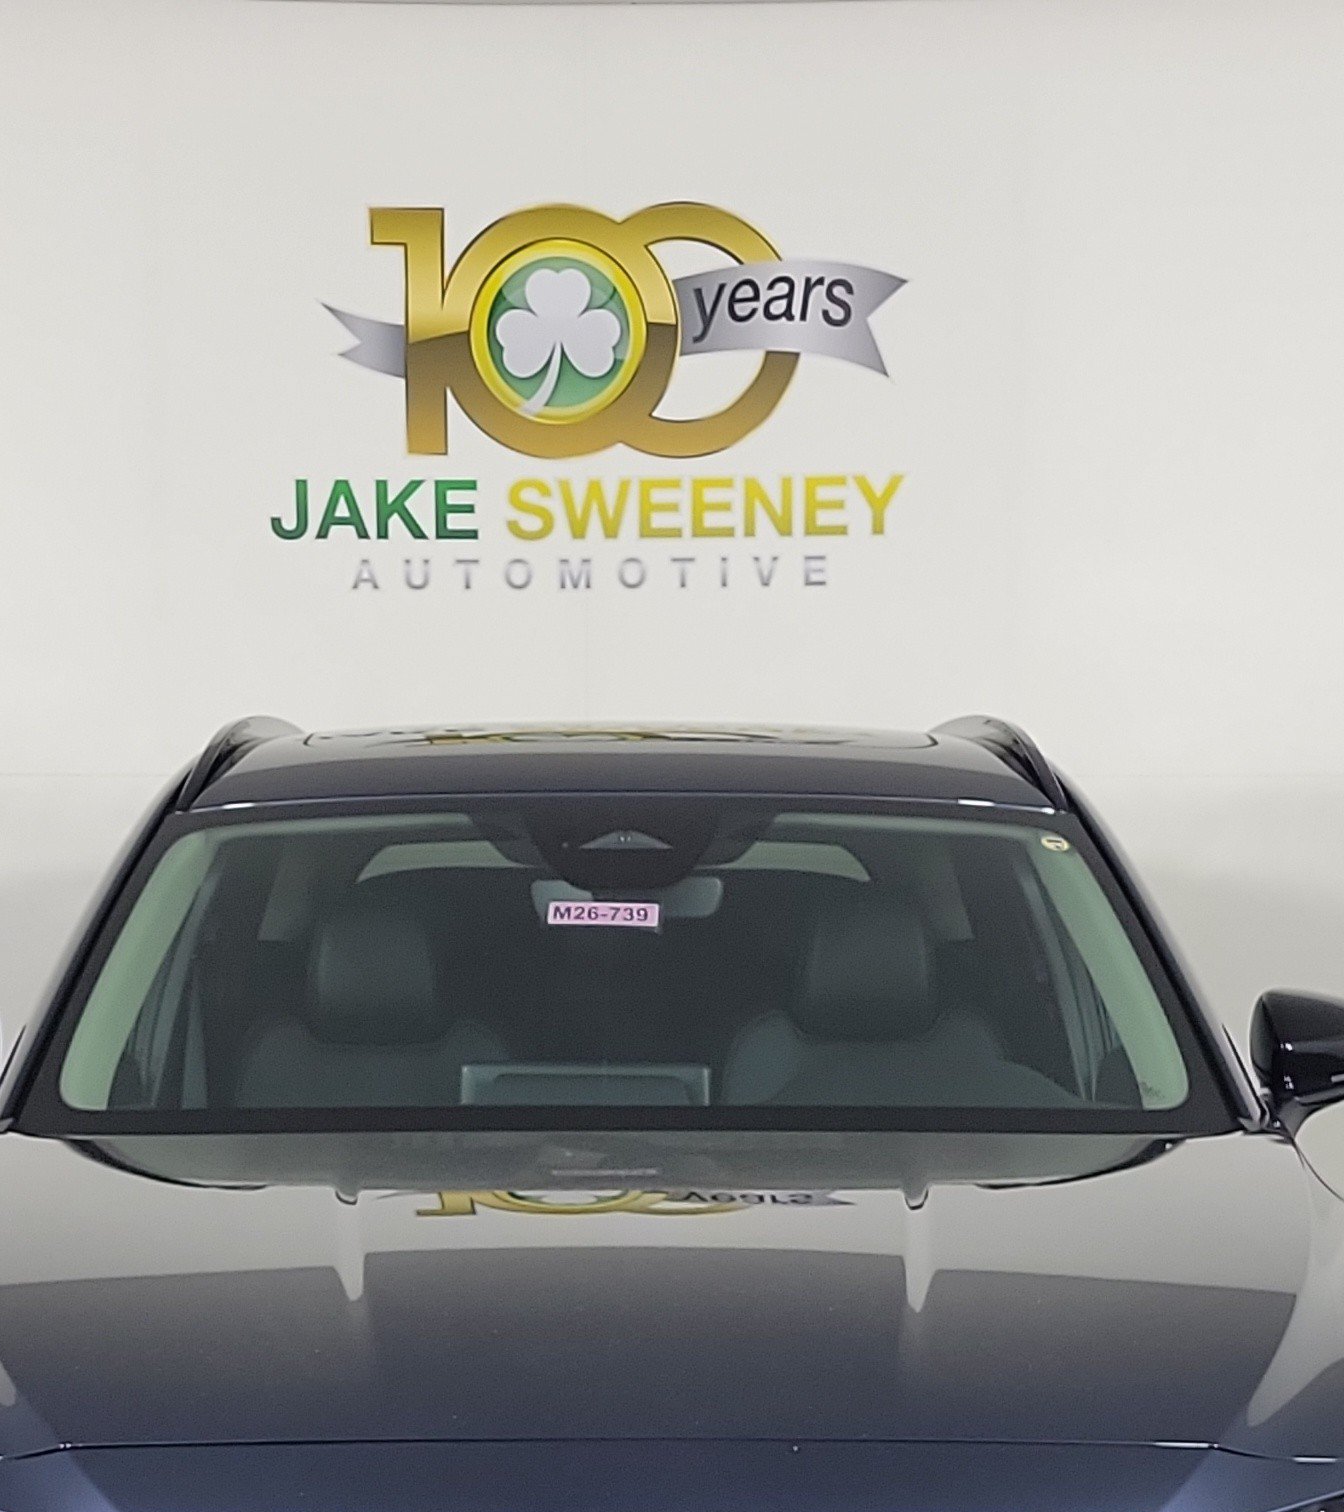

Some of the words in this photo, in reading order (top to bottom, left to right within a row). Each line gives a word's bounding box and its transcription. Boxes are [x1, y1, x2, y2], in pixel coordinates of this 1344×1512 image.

[367, 201, 801, 459] 100
[691, 274, 854, 343] years
[271, 479, 480, 541] JAKE
[506, 474, 905, 541] SWEENEY
[352, 555, 829, 591] AUTOMOTIVE
[553, 906, 648, 921] M26-739
